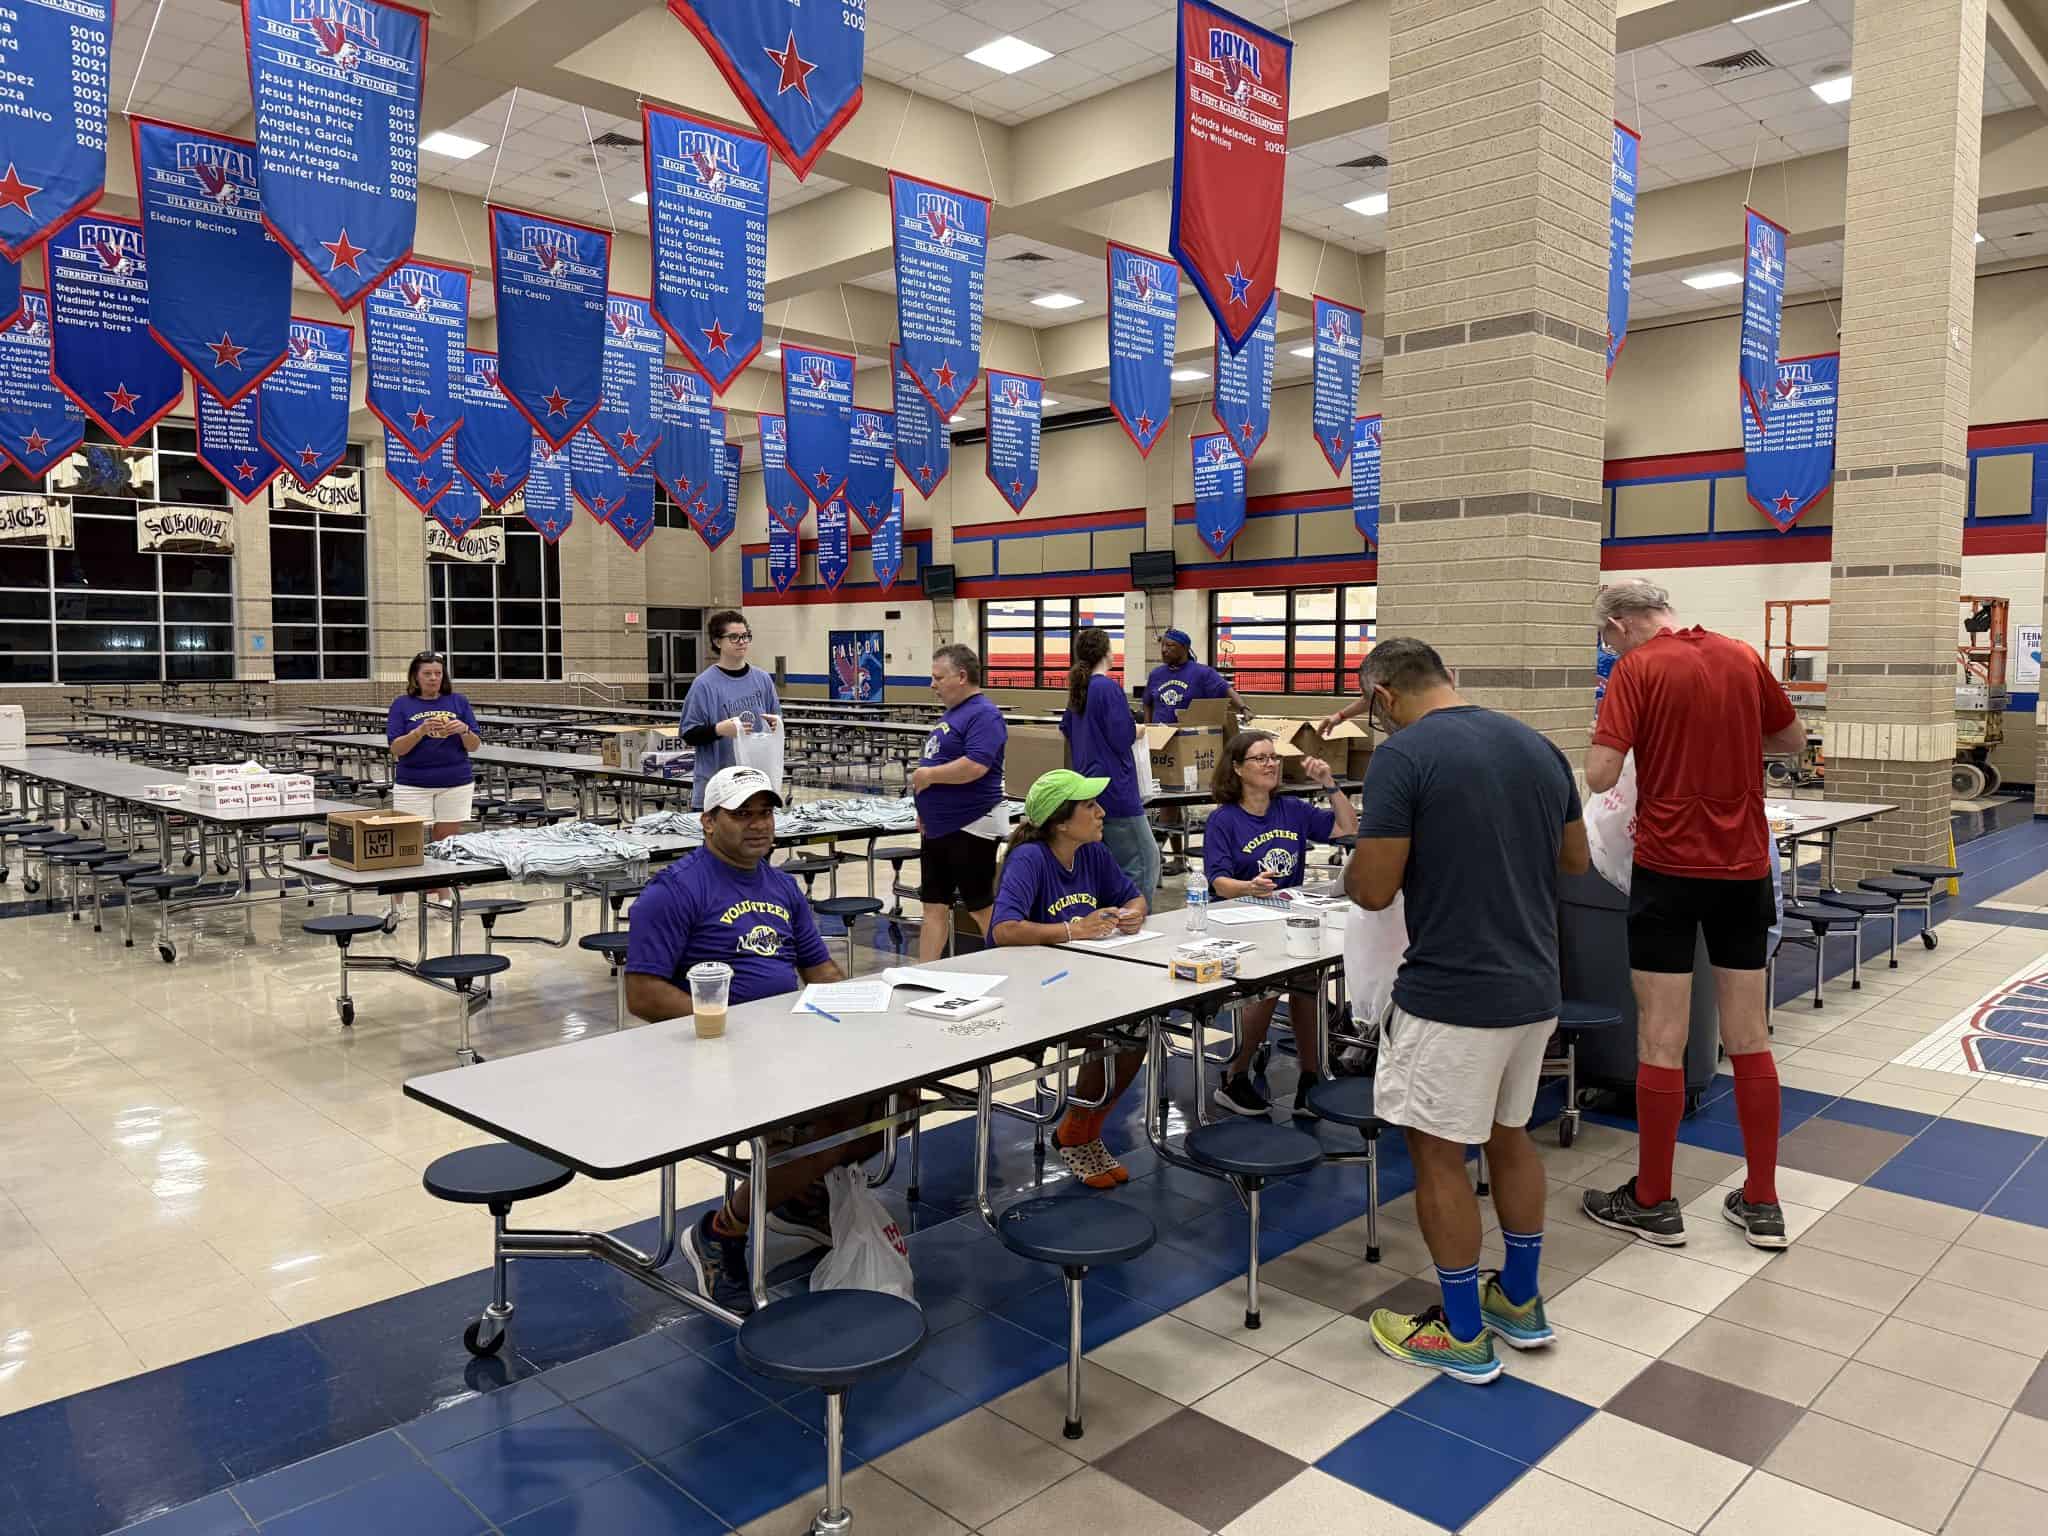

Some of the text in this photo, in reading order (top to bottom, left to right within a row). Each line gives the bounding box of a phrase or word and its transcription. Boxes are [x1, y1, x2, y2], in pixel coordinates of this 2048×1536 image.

[291, 0, 380, 48] ROYAL
[843, 10, 865, 32] 202
[70, 24, 104, 44] 2010
[72, 40, 106, 57] 2019
[268, 22, 408, 71] HIGH SCHOOL
[1209, 28, 1262, 84] ROYAL
[72, 54, 106, 72] 2021
[278, 52, 398, 94] UIL SOCIAL STUDIES
[72, 70, 106, 88] 2021
[260, 69, 364, 107] Jesus Hernandez
[1195, 62, 1280, 106] HIGH SCHOOL
[73, 86, 107, 104] 2021
[260, 84, 414, 120] Jesus Hernandez 2013
[73, 101, 108, 120] 2021
[260, 100, 414, 134] Jon'Dasha Price 2015
[1220, 100, 1284, 133] ACADEMIC CHAMPIONS
[260, 115, 416, 147] Angeles Garcia 2019
[1190, 125, 1210, 140] Ready
[1210, 132, 1232, 151] Writing
[1192, 112, 1256, 146] Alondra Melendez
[260, 130, 416, 162] Martin Mendoza 2021
[679, 130, 739, 173] ROYAL
[176, 142, 256, 187] ROYAL
[260, 144, 416, 174] Max Arteaga 2021
[157, 170, 186, 184] HIGH
[264, 160, 416, 196] Jennifer Hernandez 2022
[663, 160, 760, 192] HIGH SCHOOL
[168, 196, 224, 215] UIL READY
[390, 188, 416, 202] 2024
[694, 190, 746, 210] ACCOUNTING
[658, 200, 712, 218] Alexis Ibarra
[917, 193, 964, 230] ROYAL
[150, 211, 238, 236] Eleanor Recinos
[659, 210, 764, 232] Ian Arteaga 2021
[80, 224, 144, 258] ROYAL
[522, 226, 580, 262] ROYAL
[659, 223, 765, 245] Lissy Gonzalez 2022
[62, 248, 88, 260] HIGH
[660, 235, 682, 248] Litzie
[686, 242, 724, 258] Gonzalez
[507, 249, 598, 277] HIGH SCHOOL
[660, 248, 724, 270] Paola Gonzalez
[660, 260, 715, 278] Alexis Ibarra
[920, 259, 948, 272] Martinez
[56, 267, 144, 288] CURRENT ISSUES AND
[389, 268, 442, 298] ROYAL
[660, 272, 728, 294] Samantha Lopez
[1126, 259, 1162, 289] ROYAL
[56, 283, 128, 302] Stephanie De La
[502, 285, 550, 300] Ester Castro
[660, 283, 710, 300] Nancy Cruz
[920, 290, 950, 304] Gonzalez
[57, 294, 134, 312] Vladimir Moreno
[57, 304, 100, 318] Leonardo
[57, 314, 132, 332] Demarys Torres
[902, 309, 956, 326] Samantha Lopez
[902, 320, 924, 330] Martin
[372, 338, 428, 352] Demarys Torres
[401, 334, 424, 344] Garcia
[904, 330, 932, 342] Roberto
[372, 354, 430, 369] Eleanor Recinos
[401, 350, 424, 359] Garcia
[800, 356, 836, 379] ROYAL
[373, 380, 430, 396] Eleanor Recinos
[402, 376, 424, 386] Garcia
[857, 414, 883, 432] ROYAL
[145, 514, 226, 538] SCHOOL
[428, 529, 500, 556] FALCONS
[832, 640, 880, 658] FALCON
[1152, 754, 1176, 768] ods
[1242, 829, 1298, 854] VOLUNTEER
[1408, 1334, 1452, 1350] HOKA
